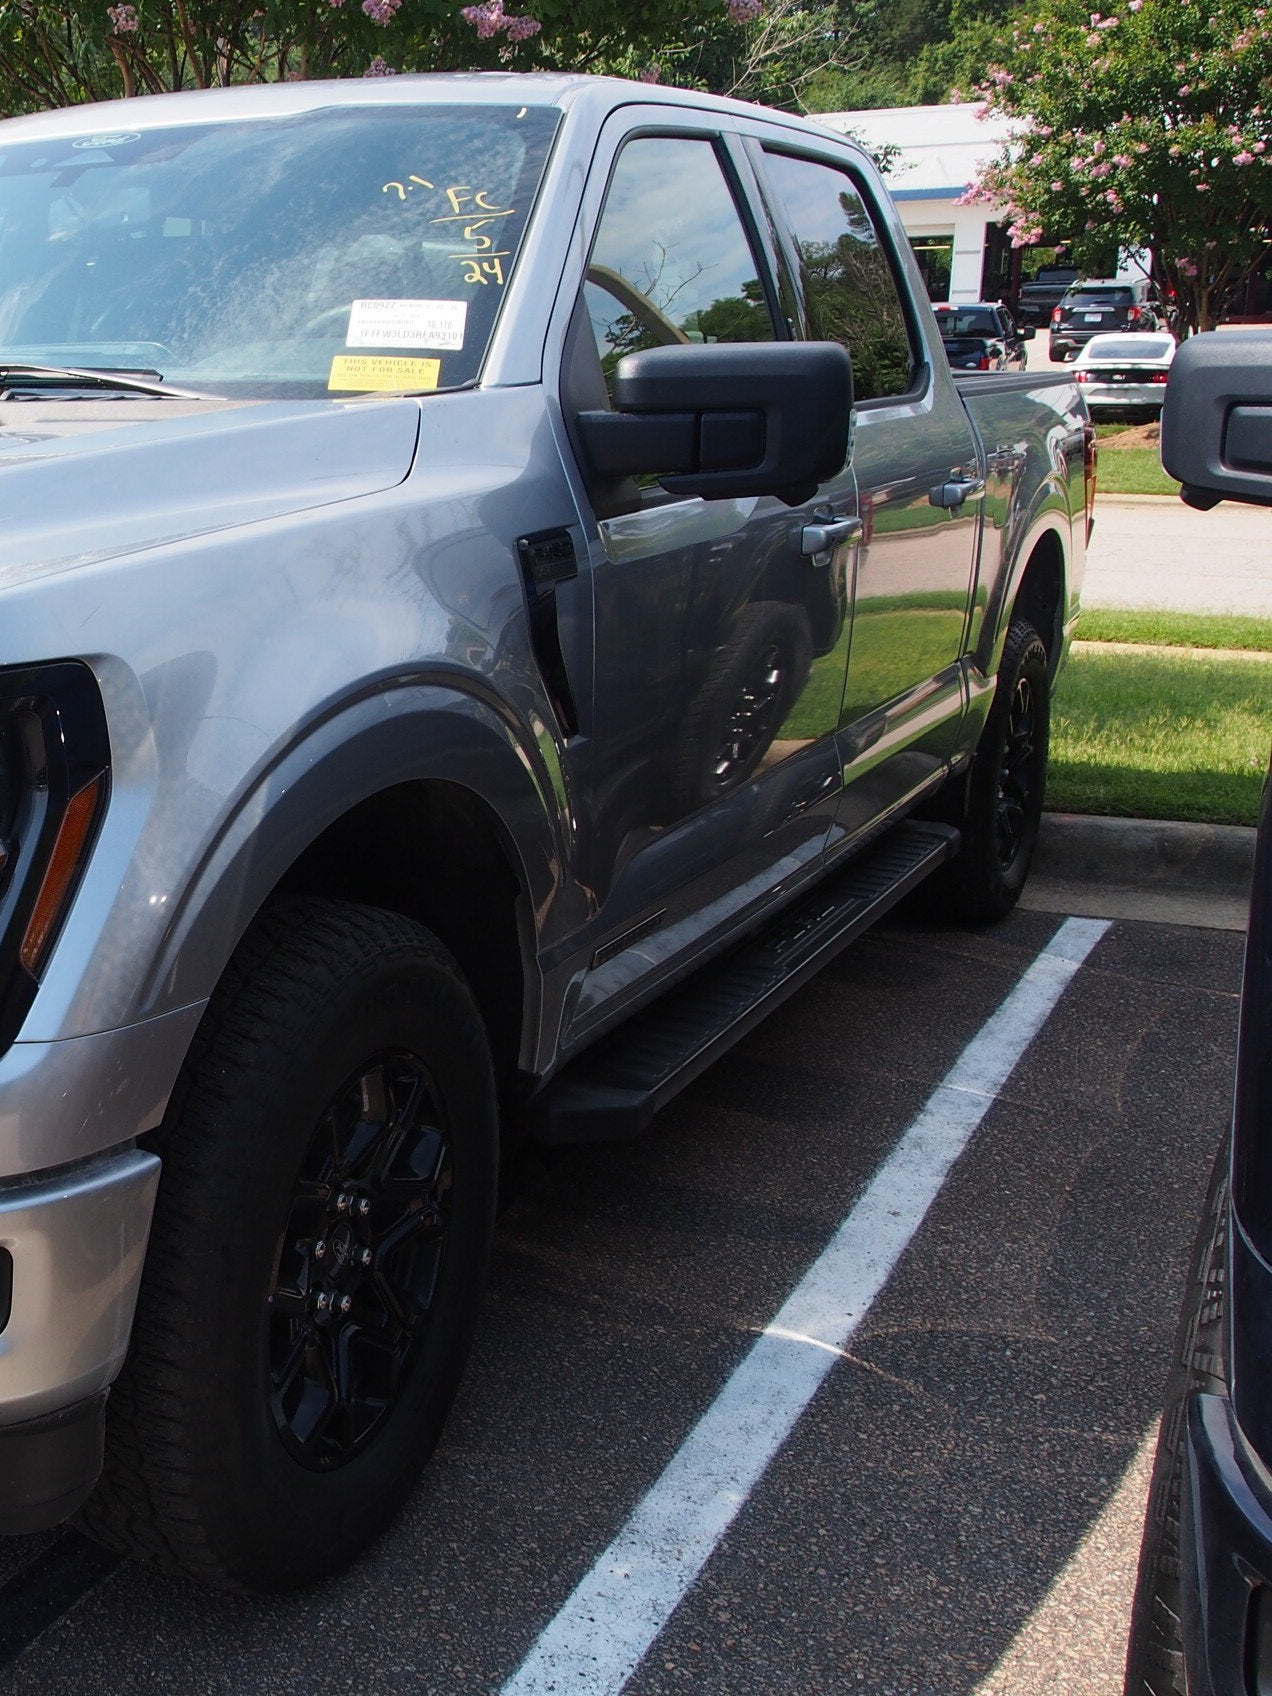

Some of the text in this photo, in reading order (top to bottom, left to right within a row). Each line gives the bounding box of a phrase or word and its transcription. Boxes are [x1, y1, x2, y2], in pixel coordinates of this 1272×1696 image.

[446, 186, 501, 213] FC
[464, 219, 495, 249] 5
[460, 258, 504, 285] 24
[371, 359, 418, 367] VEHICLE
